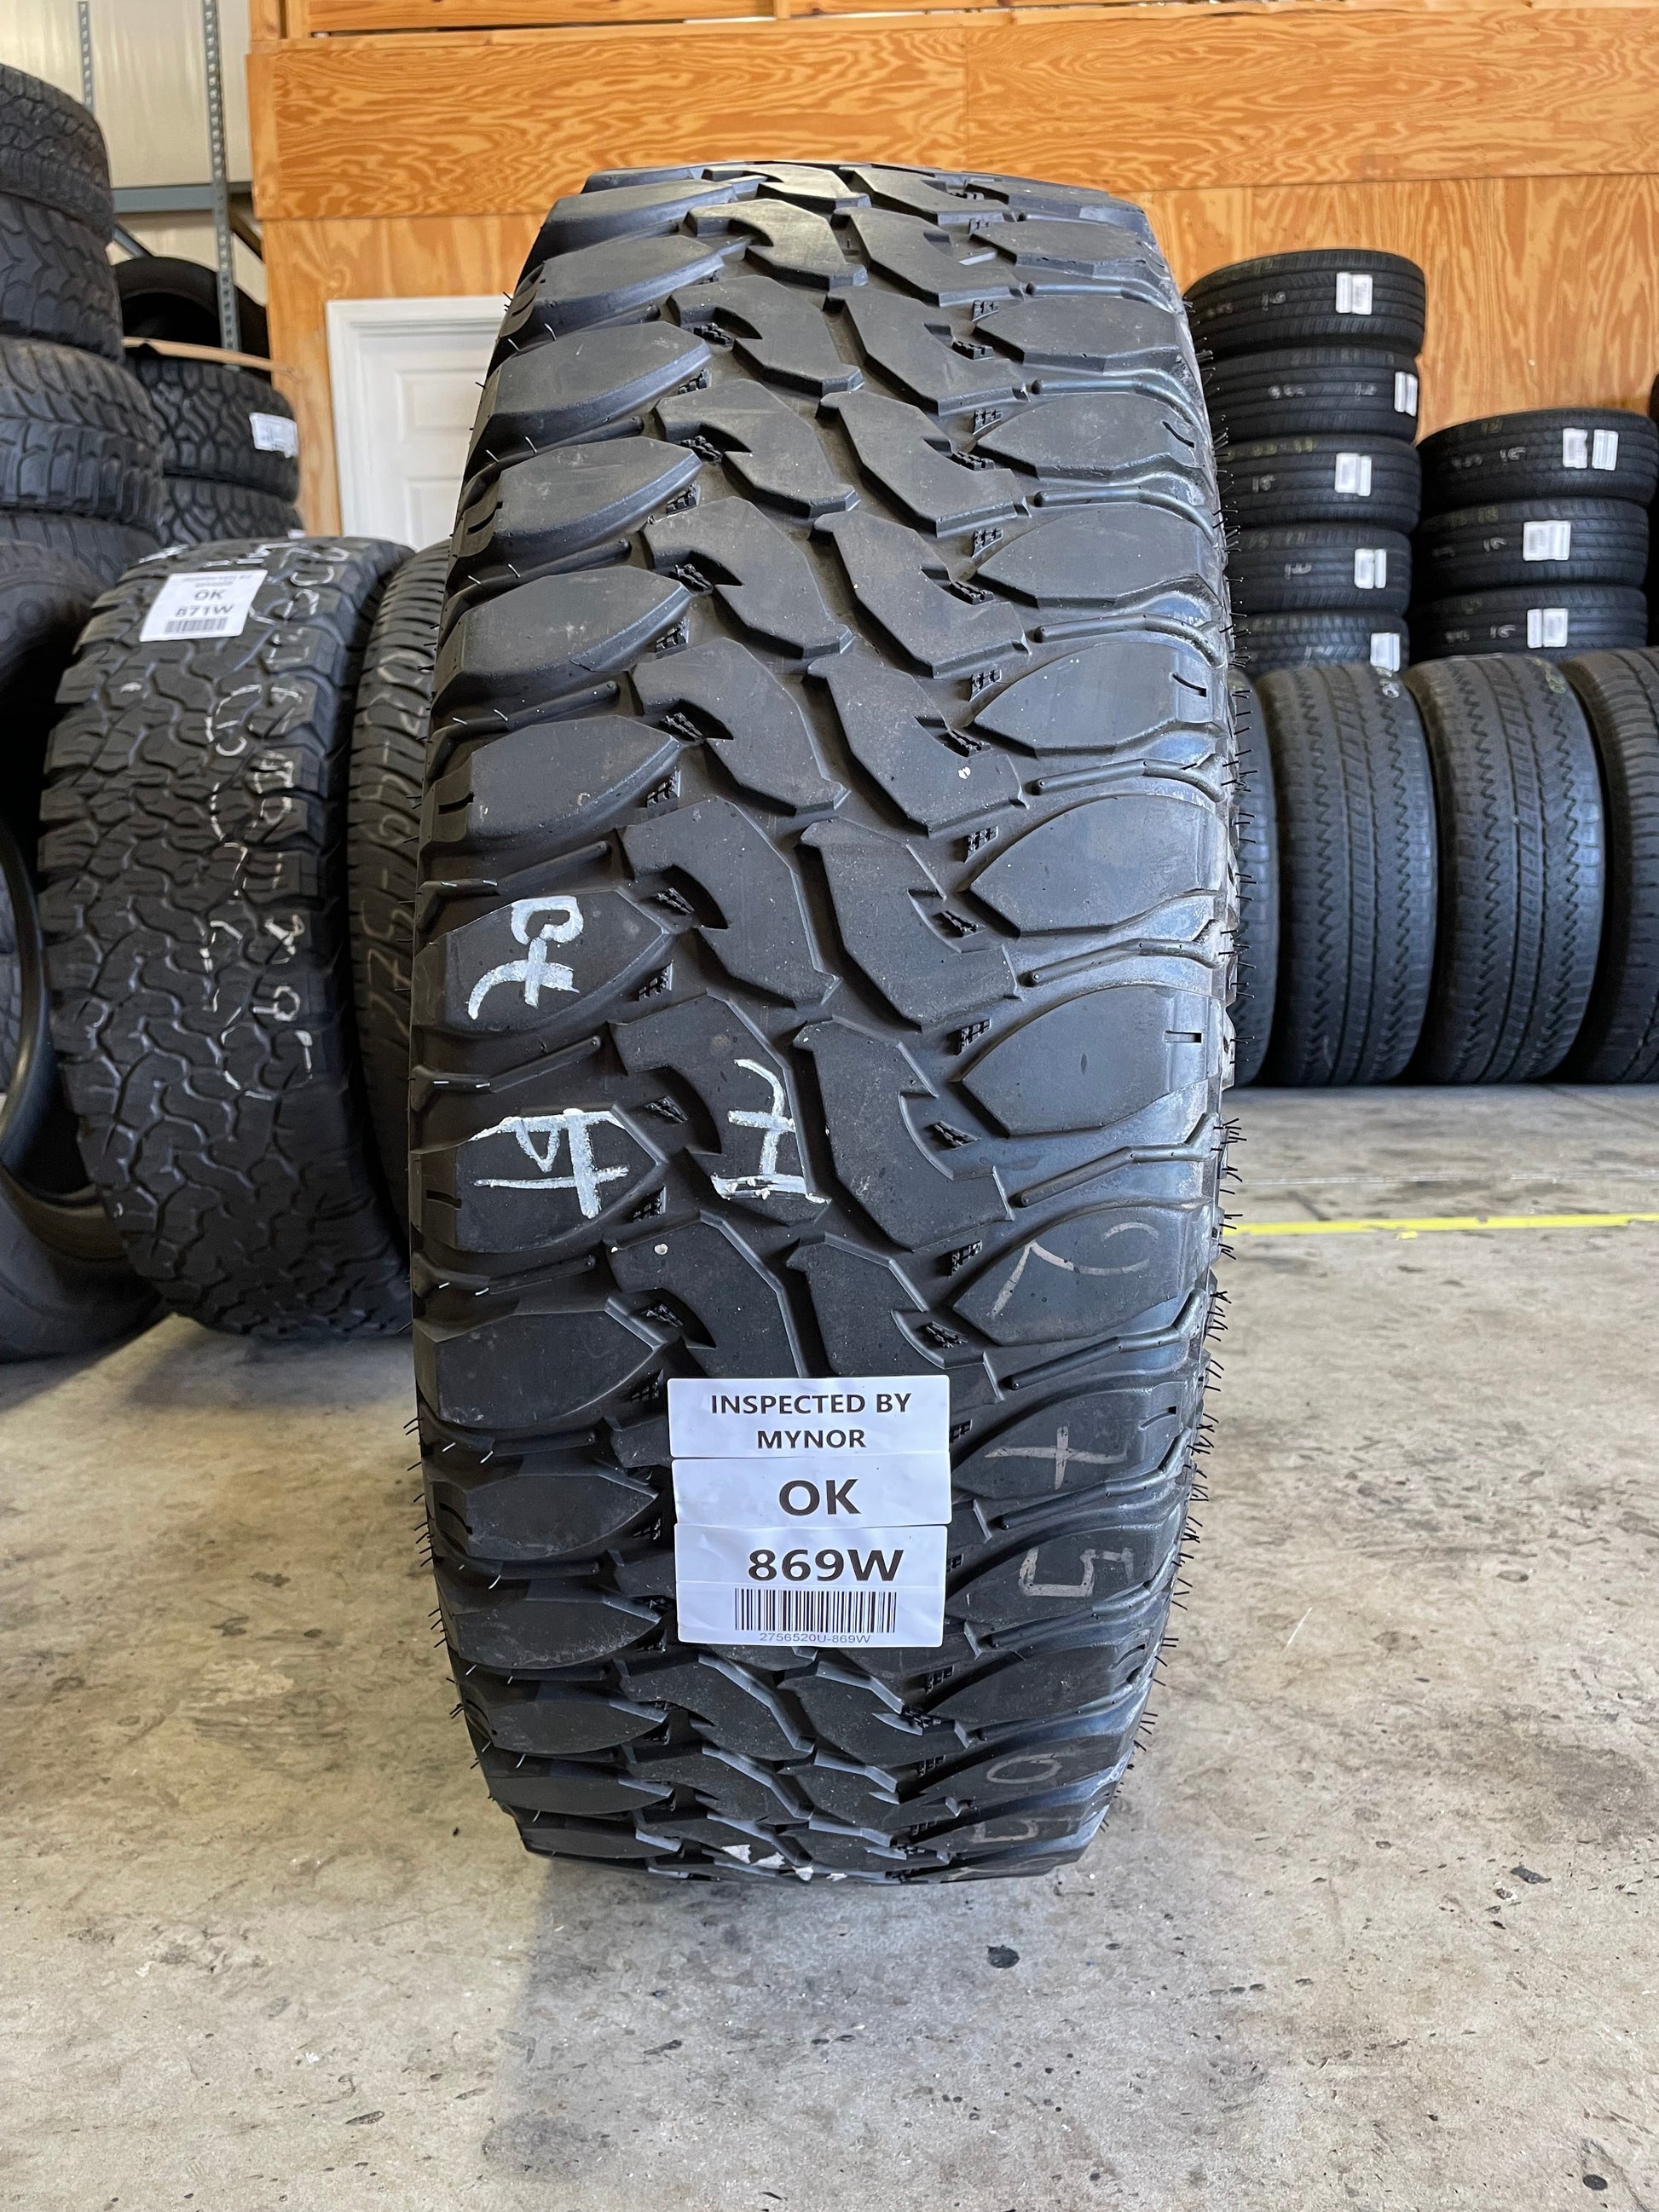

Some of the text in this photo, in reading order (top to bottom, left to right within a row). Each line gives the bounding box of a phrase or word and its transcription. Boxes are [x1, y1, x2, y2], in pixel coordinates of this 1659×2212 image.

[194, 591, 226, 601] OK
[174, 604, 234, 618] 871W
[711, 1393, 912, 1415] INSPECTED BY
[757, 1429, 867, 1449] MYNOR
[777, 1477, 862, 1516] OK
[747, 1548, 905, 1582] 869W
[759, 1632, 871, 1644] 2756520U-869W
